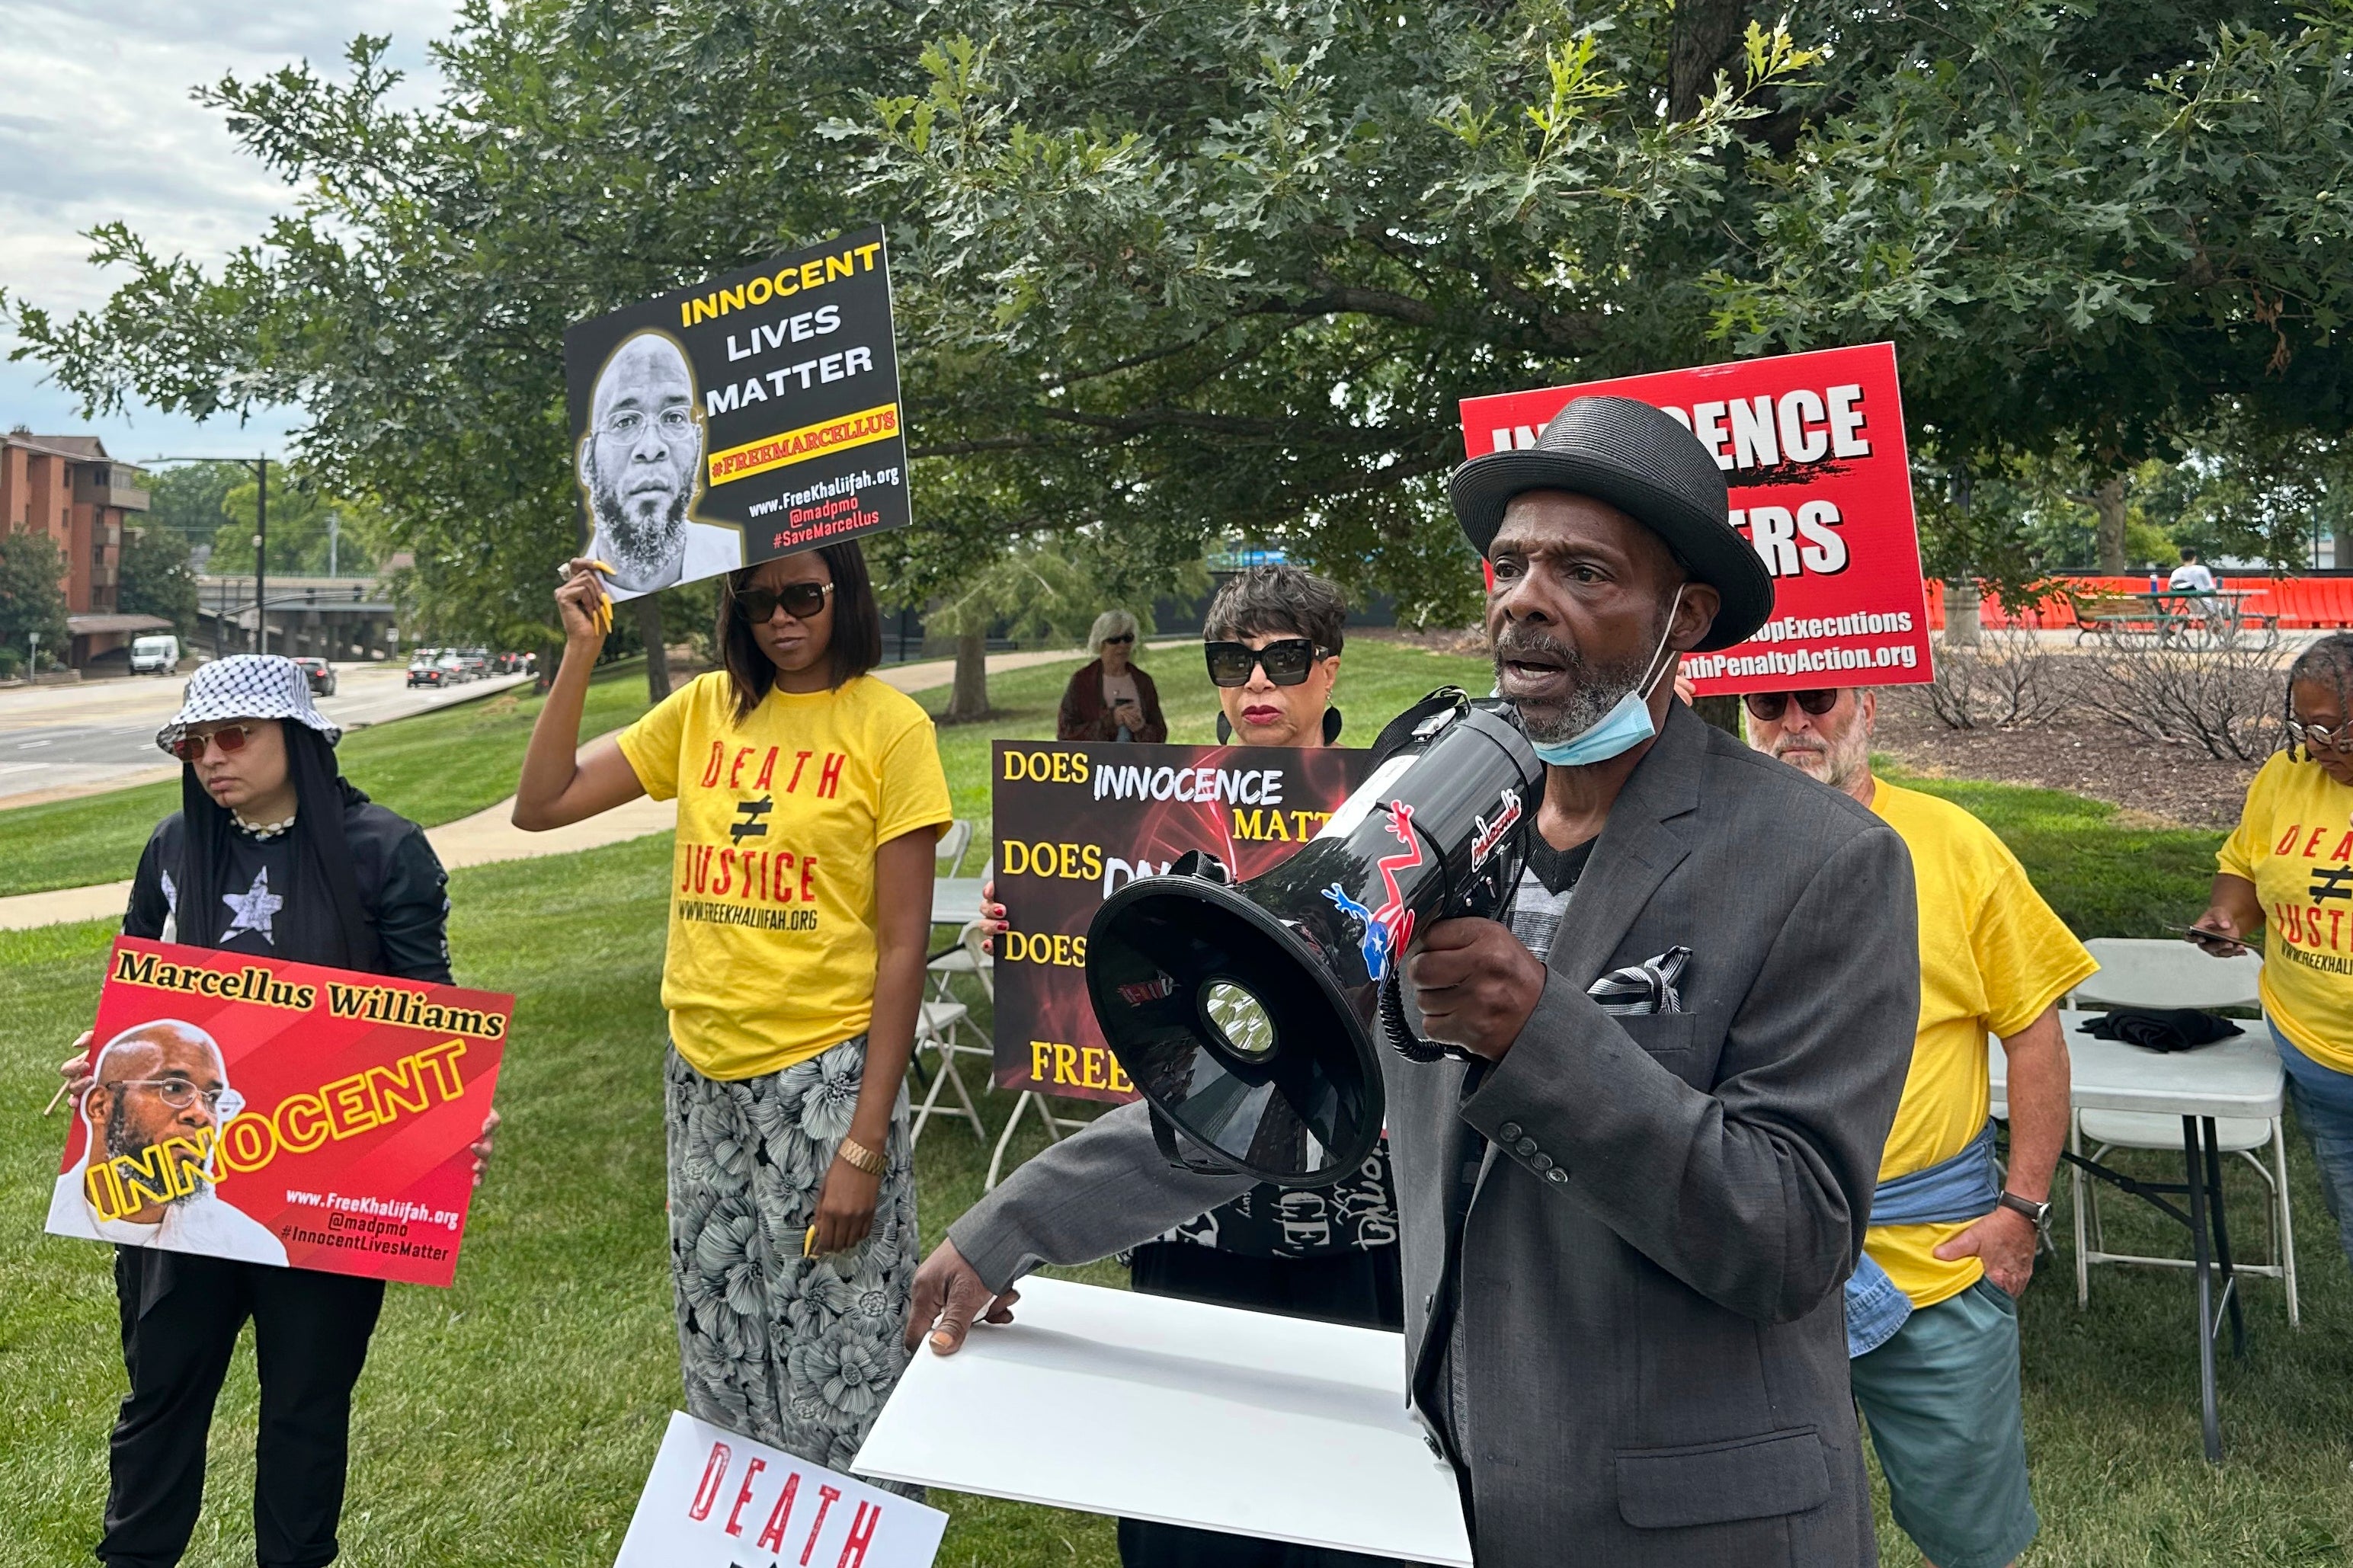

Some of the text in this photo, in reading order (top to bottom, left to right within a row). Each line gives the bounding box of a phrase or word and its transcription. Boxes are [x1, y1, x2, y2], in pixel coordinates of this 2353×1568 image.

[680, 242, 881, 328] INNOCENT
[726, 305, 842, 362] LIVES
[706, 346, 873, 417] MATTER
[712, 411, 895, 478] #FREEMARCELLUS
[749, 467, 899, 517] www.FreeKhaliifah.org
[789, 497, 859, 529] @madpmo
[773, 510, 879, 549] #SaveMarcellus
[701, 741, 846, 798] DEATH
[1003, 750, 1283, 805] DOES INNOCENCE
[682, 844, 817, 903] JUSTICE
[1003, 840, 1103, 881] DOES
[1004, 930, 1087, 968] DOES
[114, 950, 507, 1038] Marcellus Williams
[1030, 1041, 1135, 1093] FREE
[85, 1038, 468, 1221] INNOCENT
[287, 1189, 459, 1230] www.FreeKhaliifah.org
[328, 1212, 408, 1238] @madpmo
[281, 1225, 450, 1261] #InnocentLivesMatter
[689, 1441, 882, 1568] DEATH
